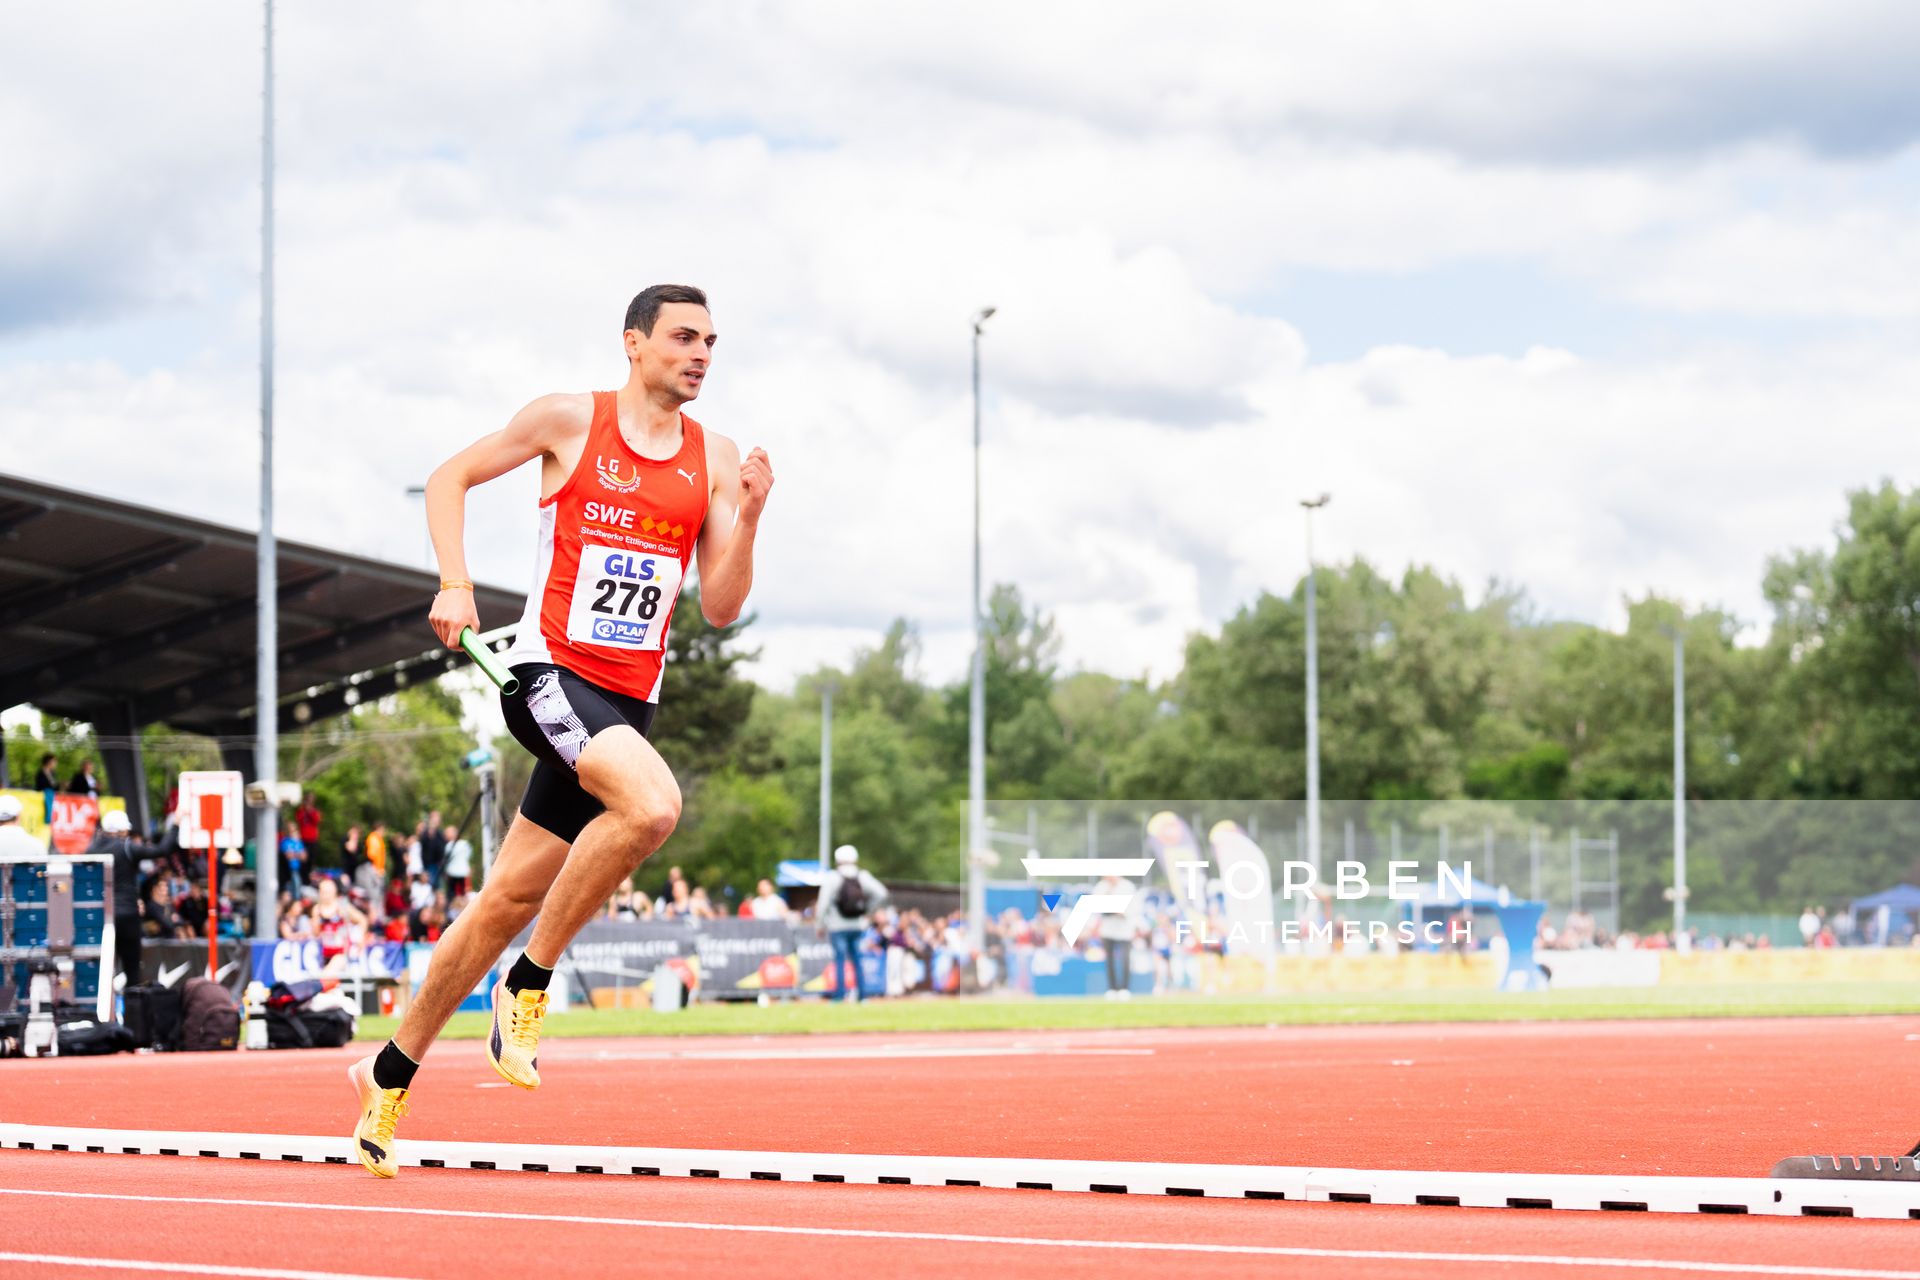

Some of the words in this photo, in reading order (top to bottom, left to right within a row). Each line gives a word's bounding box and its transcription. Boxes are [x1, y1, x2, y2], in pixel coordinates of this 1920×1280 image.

[583, 501, 637, 529] SWE
[580, 526, 624, 542] Stadtwerke
[625, 535, 657, 550] Ettlingen
[657, 544, 679, 555] GmbH
[590, 579, 662, 620] 278
[616, 624, 646, 637] PLAN
